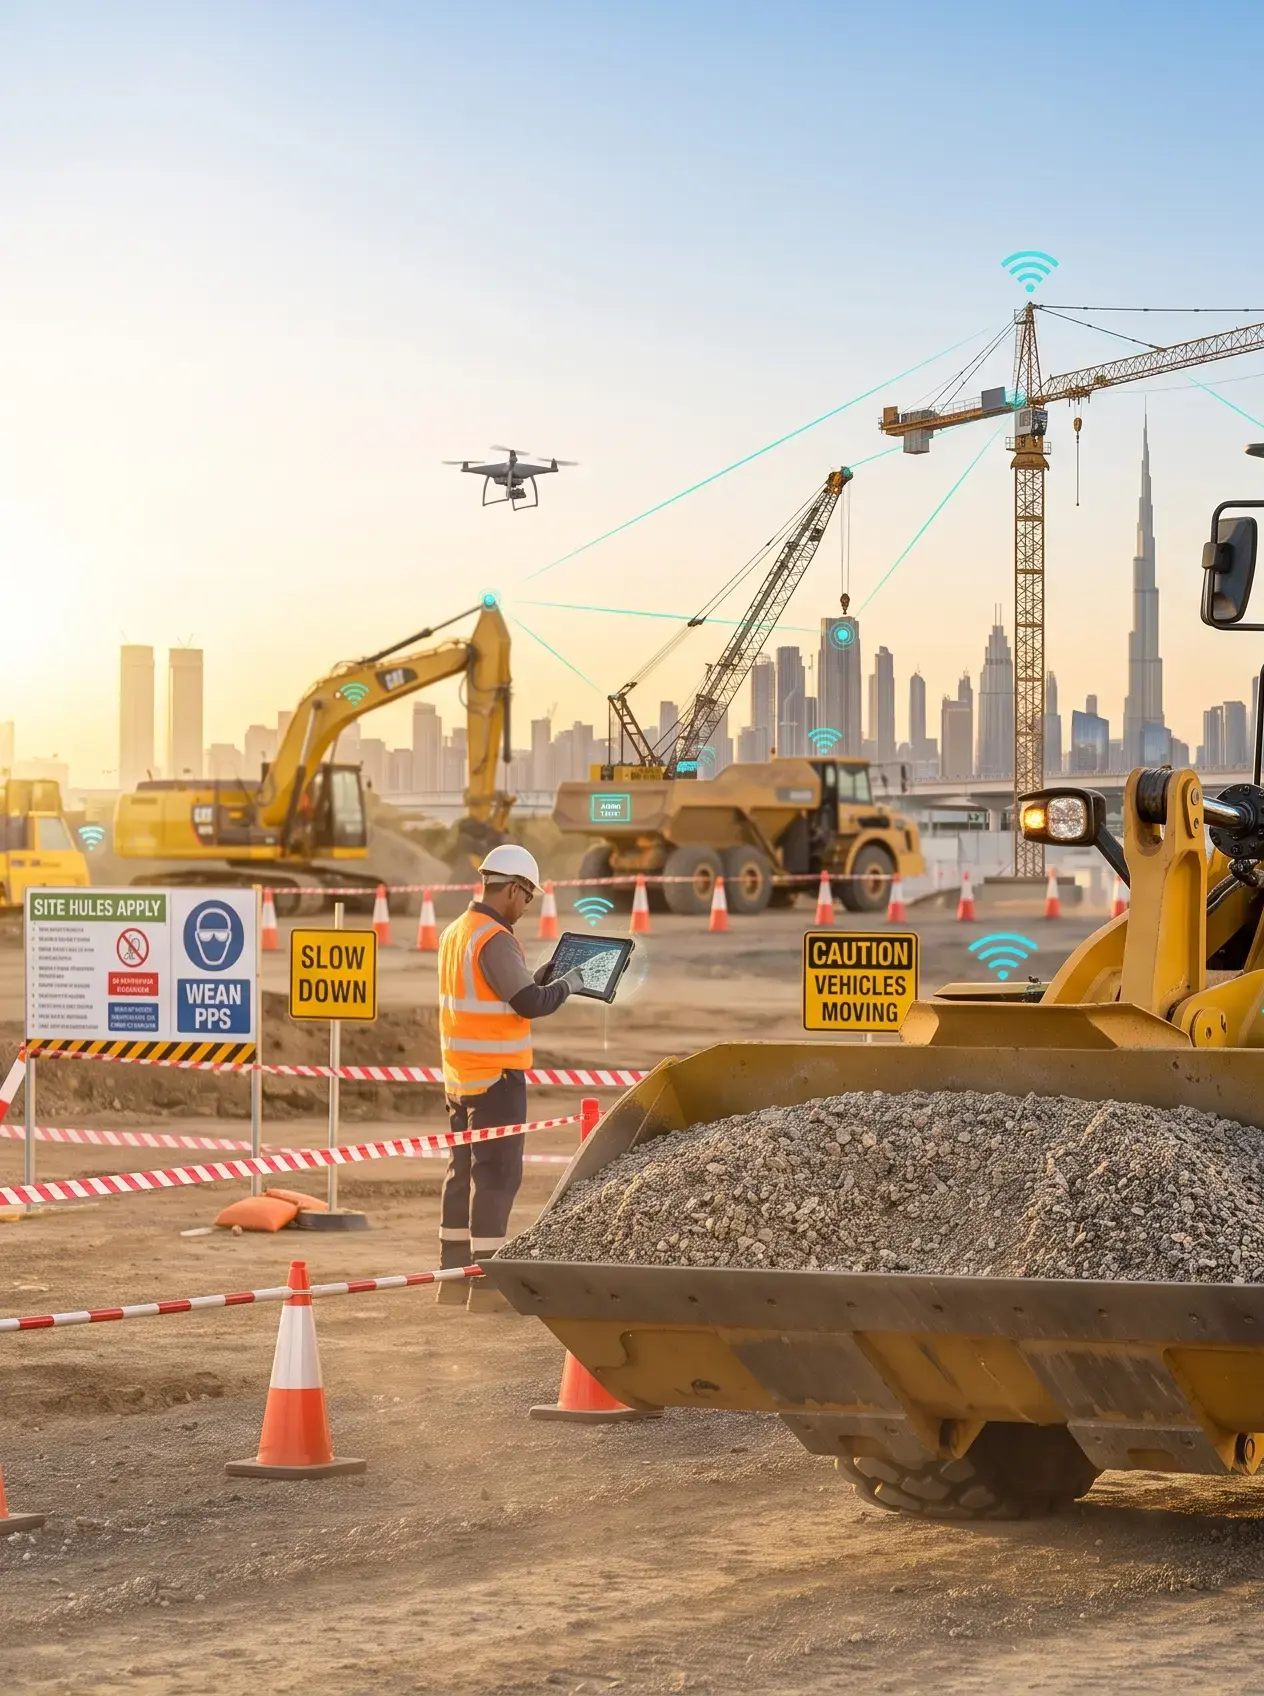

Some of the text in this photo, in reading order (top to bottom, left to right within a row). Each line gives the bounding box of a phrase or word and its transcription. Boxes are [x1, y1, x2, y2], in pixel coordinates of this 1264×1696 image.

[34, 898, 162, 917] SITE HULES APPLY
[301, 944, 366, 970] SLOW
[813, 941, 908, 966] CAUTION
[185, 983, 242, 1006] WEAN
[299, 978, 366, 1004] DOWN
[814, 974, 907, 996] VEHICLES
[194, 1007, 232, 1031] PPS
[822, 1001, 898, 1023] MOVING
